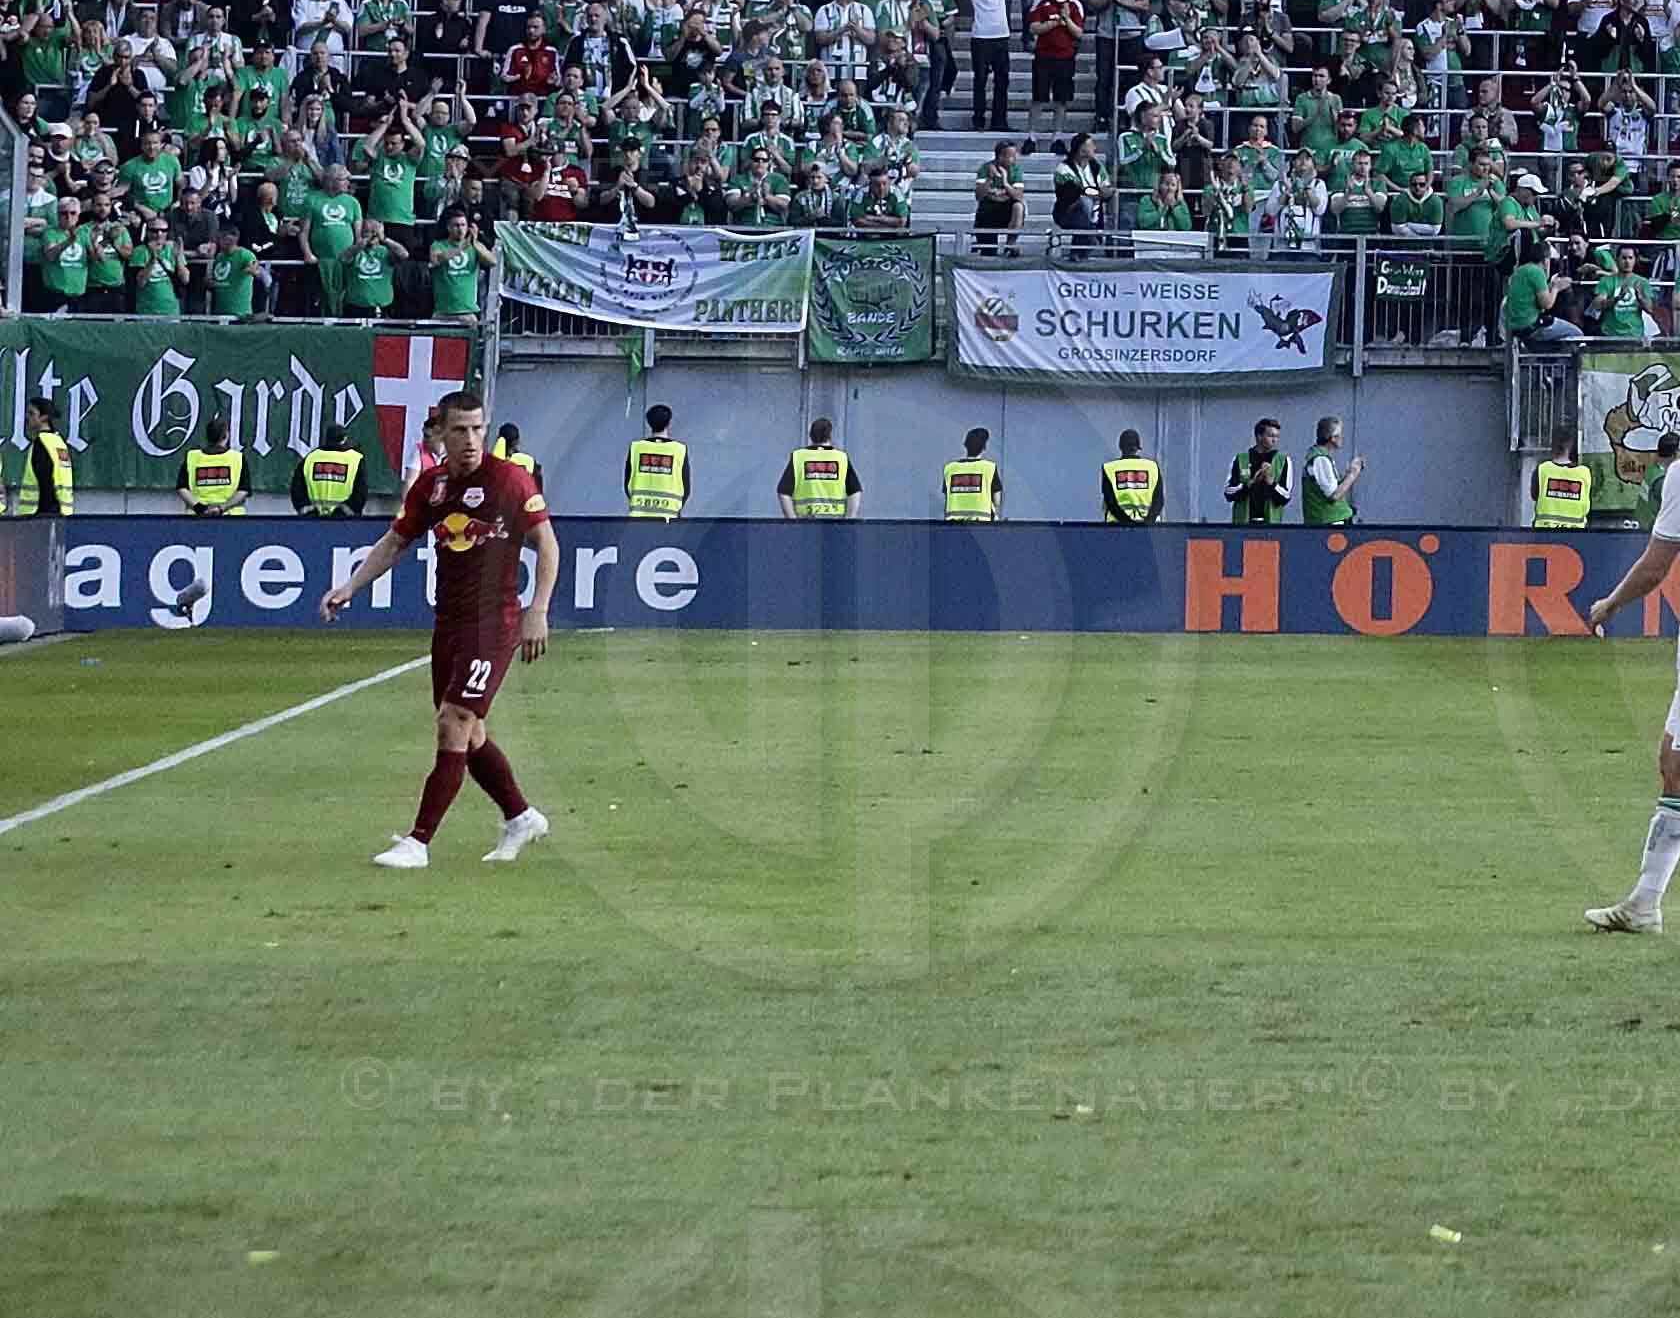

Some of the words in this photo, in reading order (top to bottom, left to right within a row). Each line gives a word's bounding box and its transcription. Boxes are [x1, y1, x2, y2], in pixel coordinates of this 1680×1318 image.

[1057, 282, 1117, 302] GRÜN
[1140, 282, 1220, 302] WEISSE
[847, 312, 896, 324] BANDE
[1035, 308, 1242, 342] SCHURKEN
[1057, 346, 1218, 363] GROSSINZERSDORF
[132, 348, 365, 458] Garde
[467, 659, 492, 691] 22
